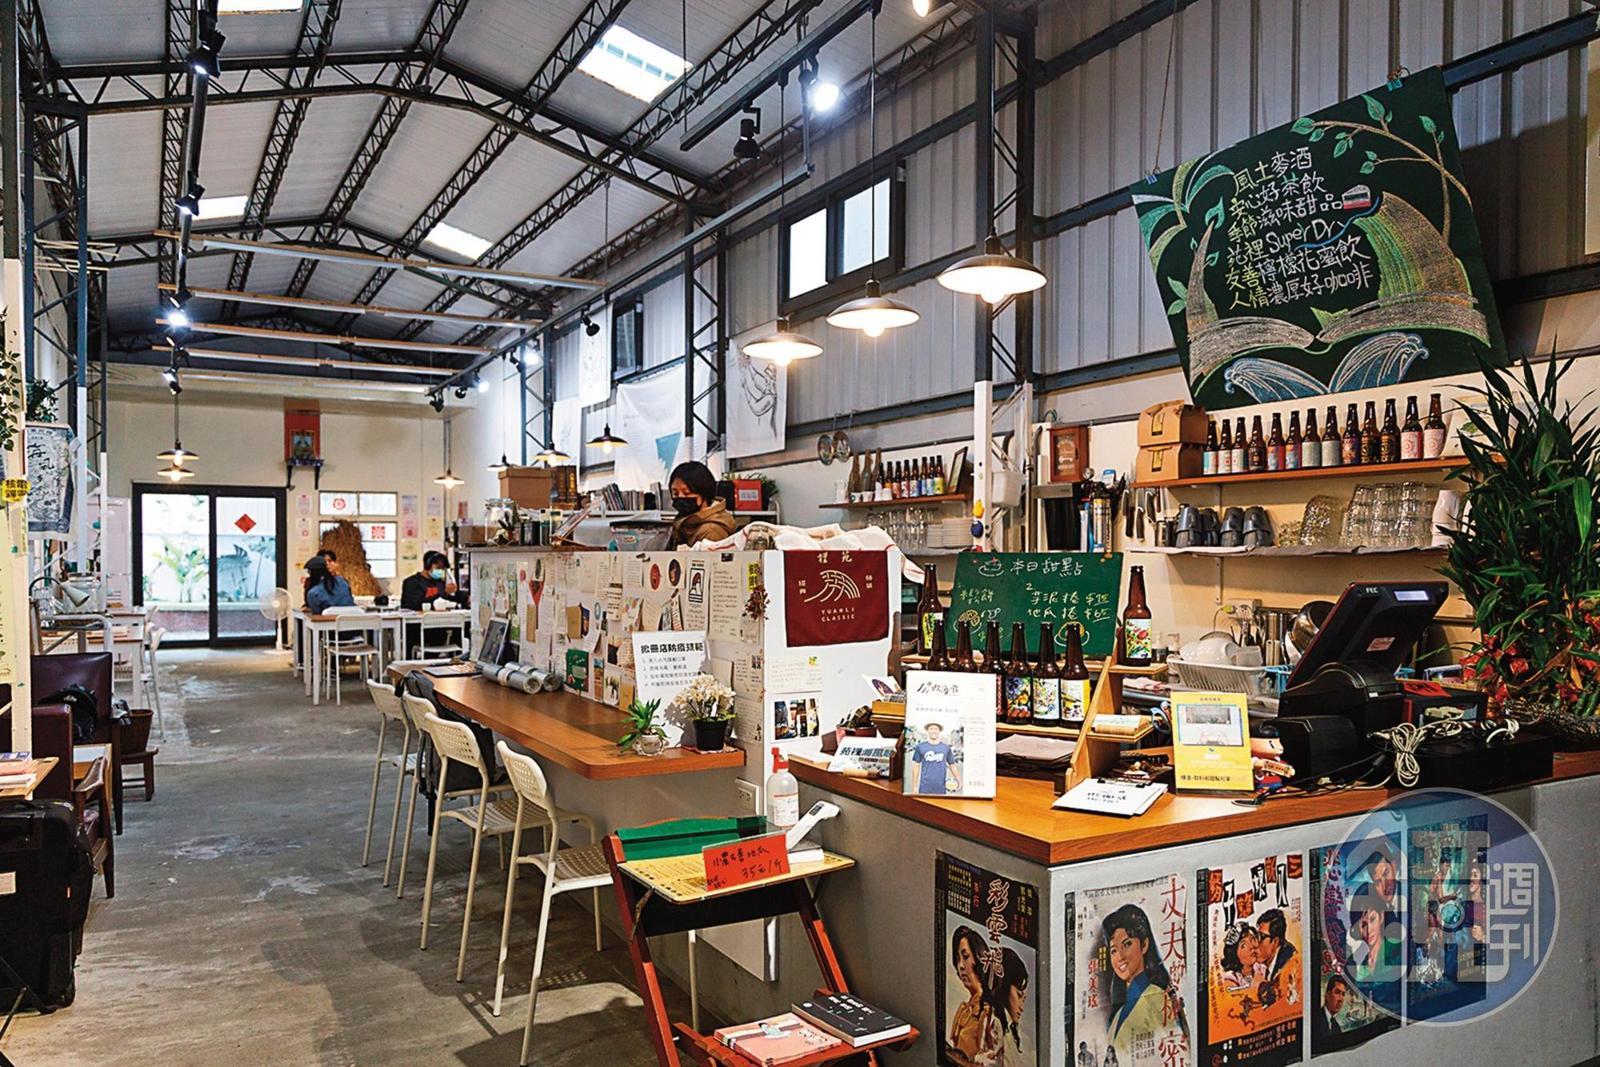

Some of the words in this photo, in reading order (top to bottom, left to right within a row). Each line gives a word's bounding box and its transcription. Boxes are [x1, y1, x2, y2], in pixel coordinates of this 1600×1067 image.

[1228, 171, 1327, 221] 安心好茶飲
[1233, 146, 1312, 196] 風土麥酒
[1227, 193, 1343, 243] 季節滋味甜品
[1225, 234, 1371, 290] 友善檸檬花蜜飲
[1229, 261, 1373, 310] 人情濃厚好咖啡
[1010, 557, 1084, 577] 本日甜點
[821, 614, 855, 623] CLASSIC
